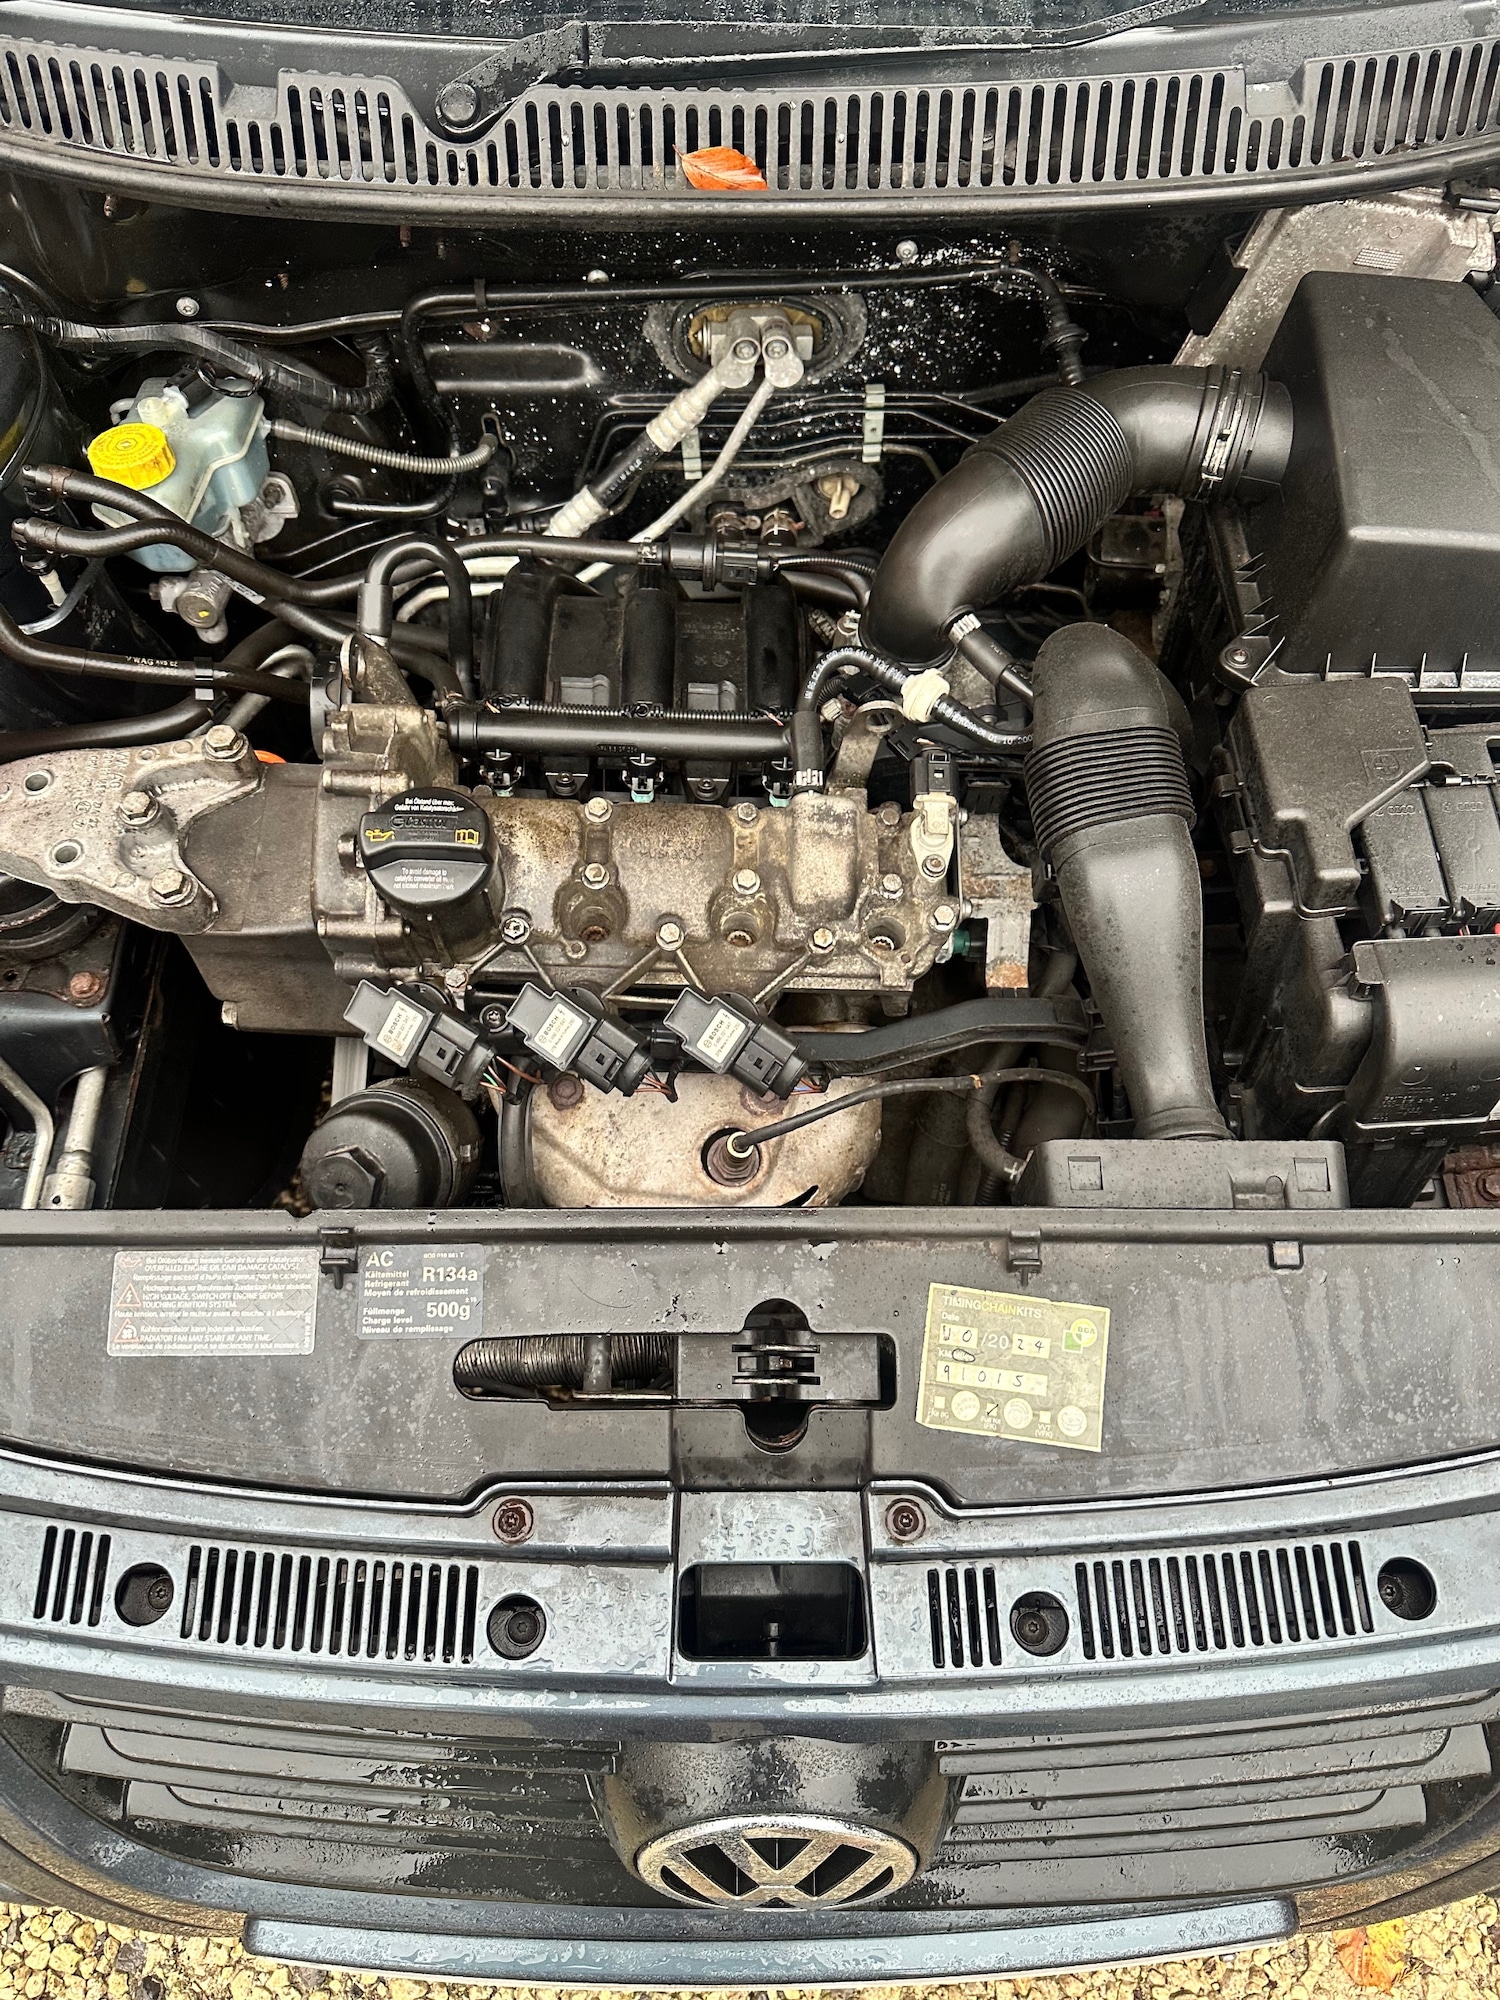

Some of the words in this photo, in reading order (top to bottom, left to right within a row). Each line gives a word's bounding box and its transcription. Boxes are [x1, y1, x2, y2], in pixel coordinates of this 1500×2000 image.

[422, 868, 441, 876] damage
[388, 1013, 402, 1034] BOSCH
[544, 1016, 559, 1035] BOSCH
[709, 1020, 724, 1040] BOSCH
[366, 1250, 394, 1267] AC
[144, 1264, 184, 1272] OVERFILLED
[365, 1270, 409, 1279] Kältemittel
[422, 1266, 478, 1282] R134a
[364, 1280, 409, 1289] Refrigerant
[191, 1292, 218, 1300] SWITCH
[364, 1289, 391, 1298] Moyen
[394, 1288, 404, 1296] de
[406, 1288, 469, 1296] refroidissement
[363, 1307, 405, 1316] Füllmenge
[426, 1301, 470, 1320] 500g
[362, 1317, 391, 1325] Charge
[393, 1316, 413, 1324] level
[942, 1311, 960, 1322] Date
[362, 1326, 390, 1334] Niveau
[392, 1325, 403, 1333] de
[405, 1325, 454, 1334] remplissage
[1077, 1326, 1096, 1335] BGA
[174, 1334, 187, 1342] FAN
[189, 1334, 203, 1342] MAY
[1018, 1338, 1044, 1354] 24
